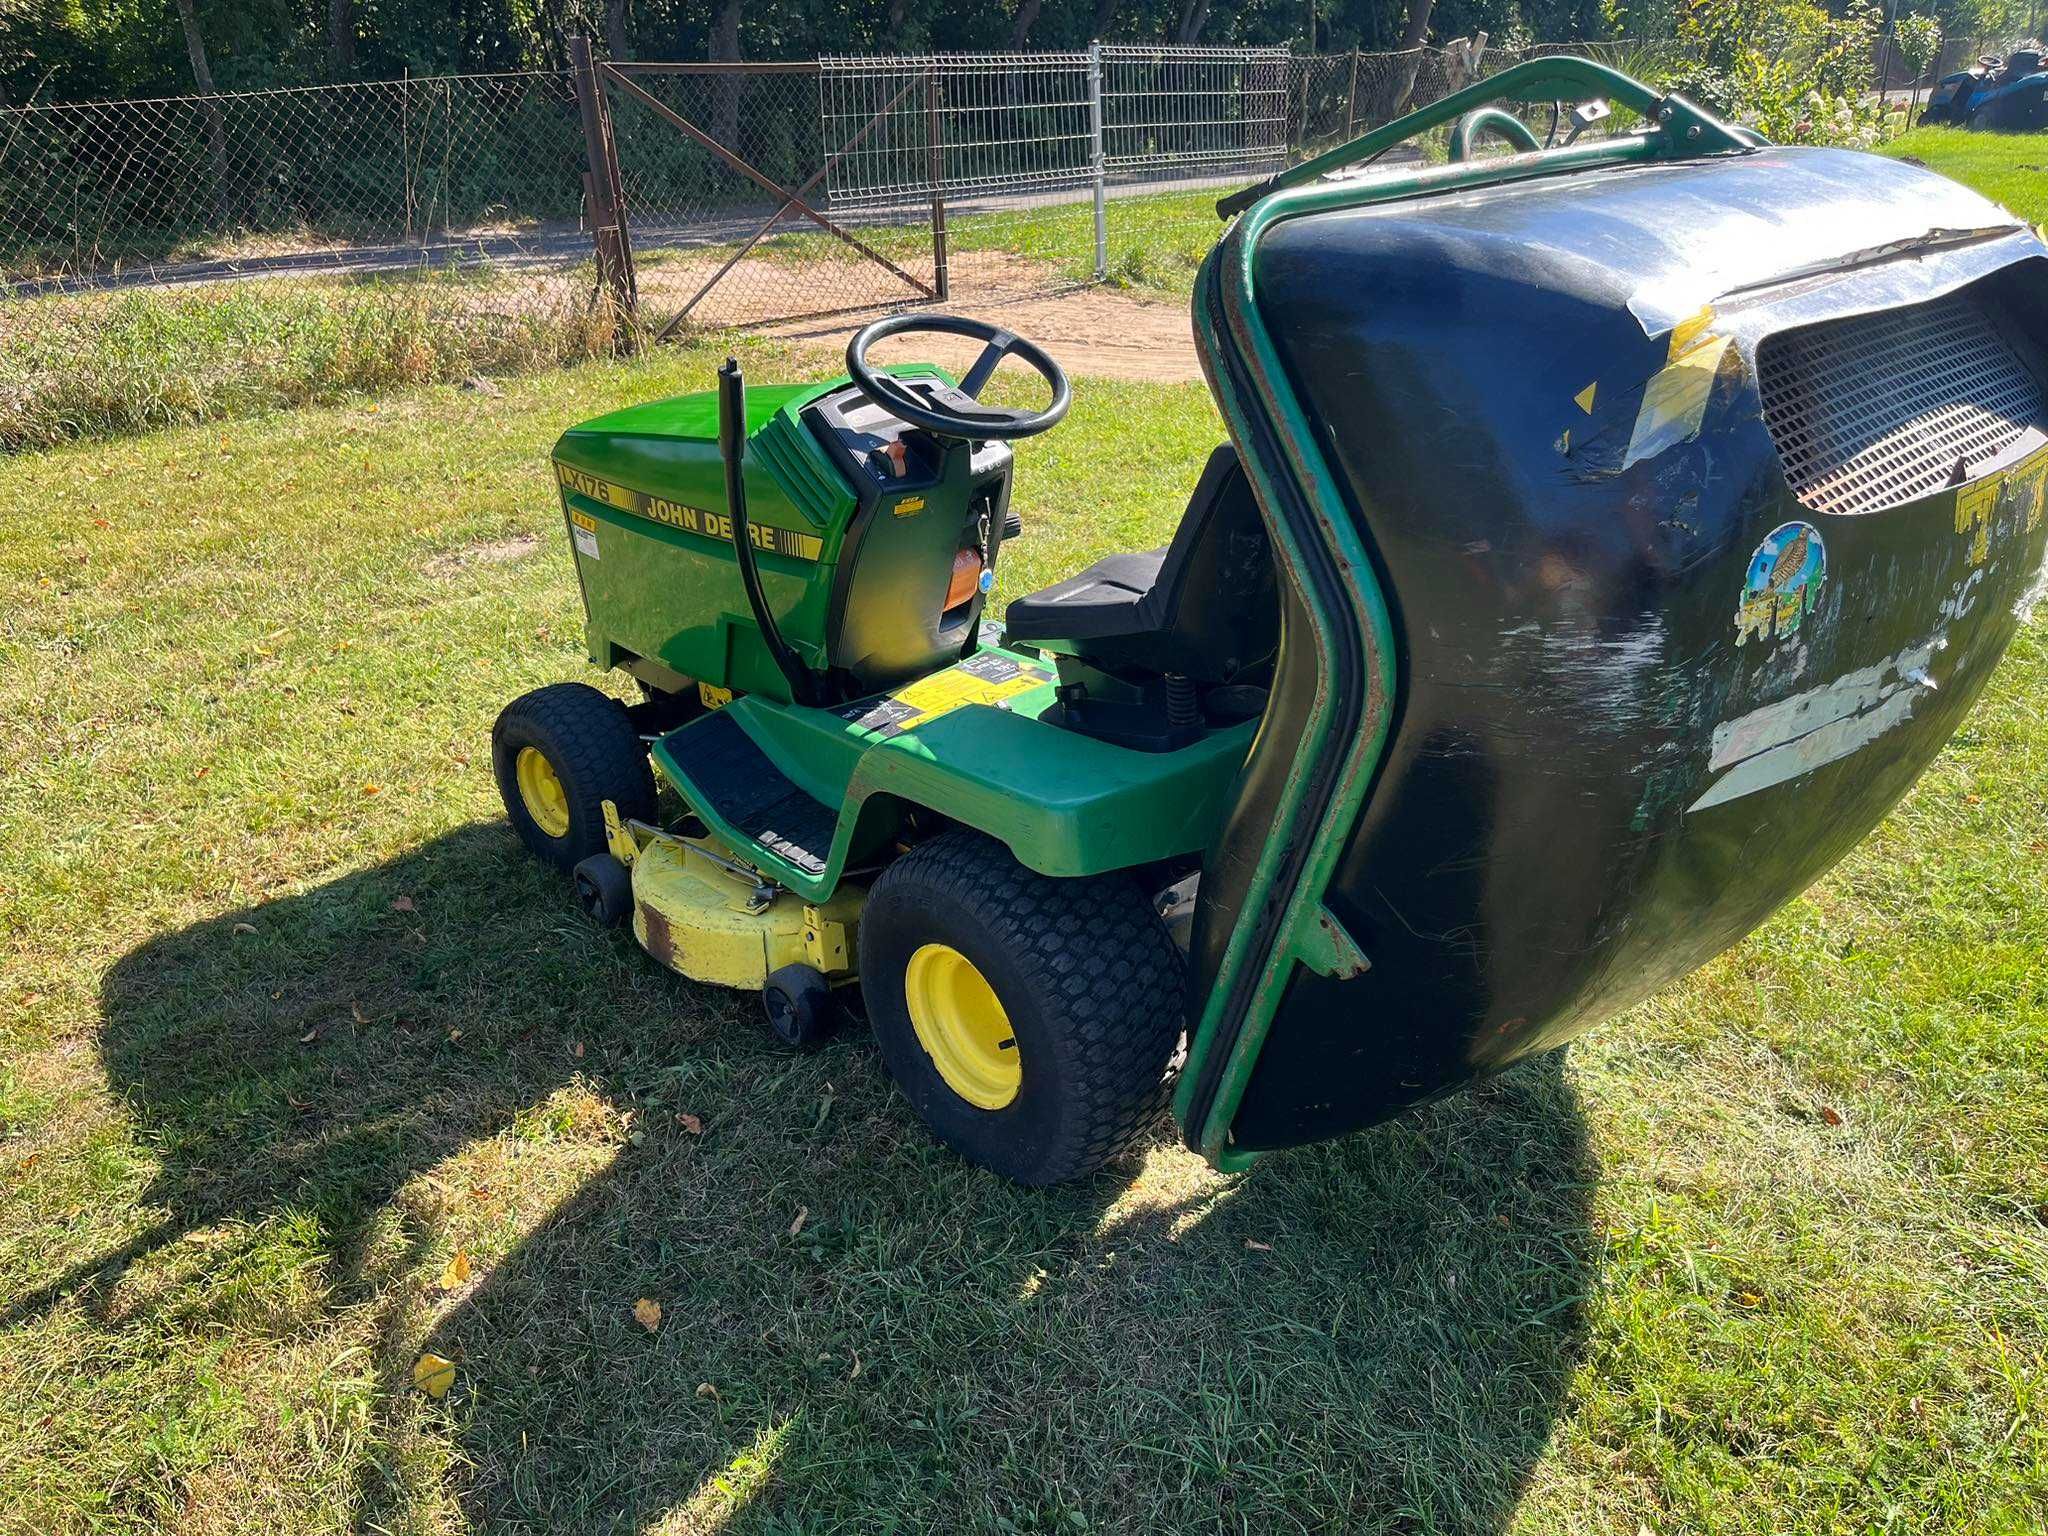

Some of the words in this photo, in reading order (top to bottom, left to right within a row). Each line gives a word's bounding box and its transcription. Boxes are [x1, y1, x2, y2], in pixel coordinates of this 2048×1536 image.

[561, 466, 610, 502] LX176
[647, 497, 698, 530] JOHN
[704, 512, 776, 550] DERE
